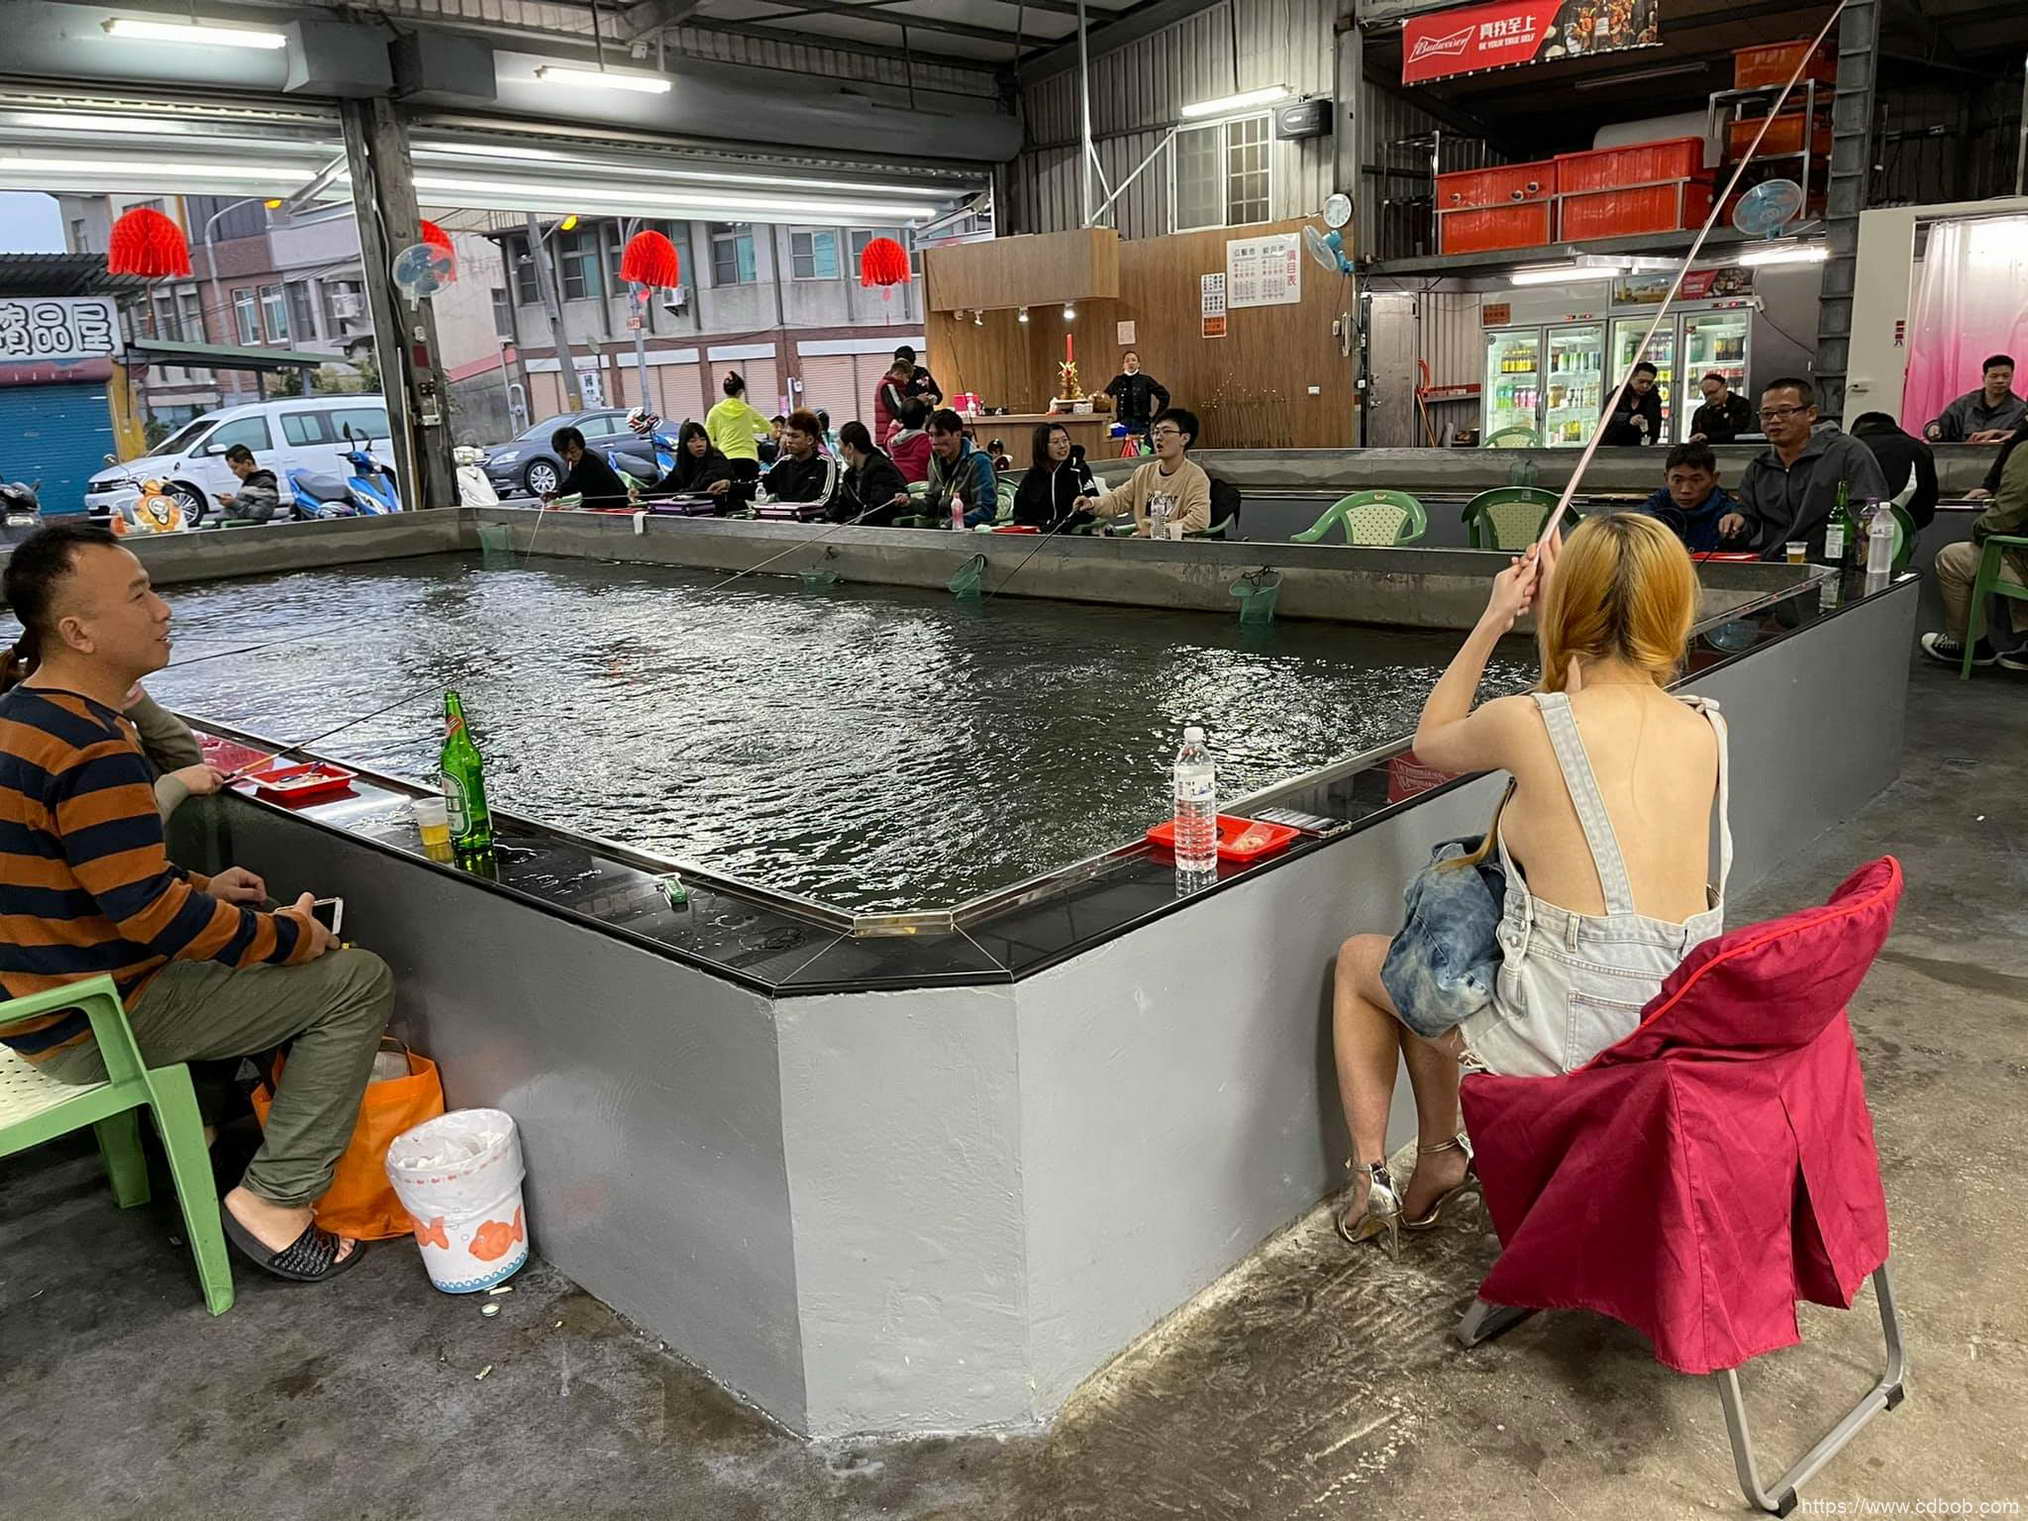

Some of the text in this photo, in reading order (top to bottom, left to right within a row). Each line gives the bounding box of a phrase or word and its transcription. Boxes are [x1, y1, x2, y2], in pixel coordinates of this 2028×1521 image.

[1480, 15, 1536, 40] 真我至上
[1415, 37, 1466, 56] Budweiser
[1488, 39, 1504, 49] YOUR
